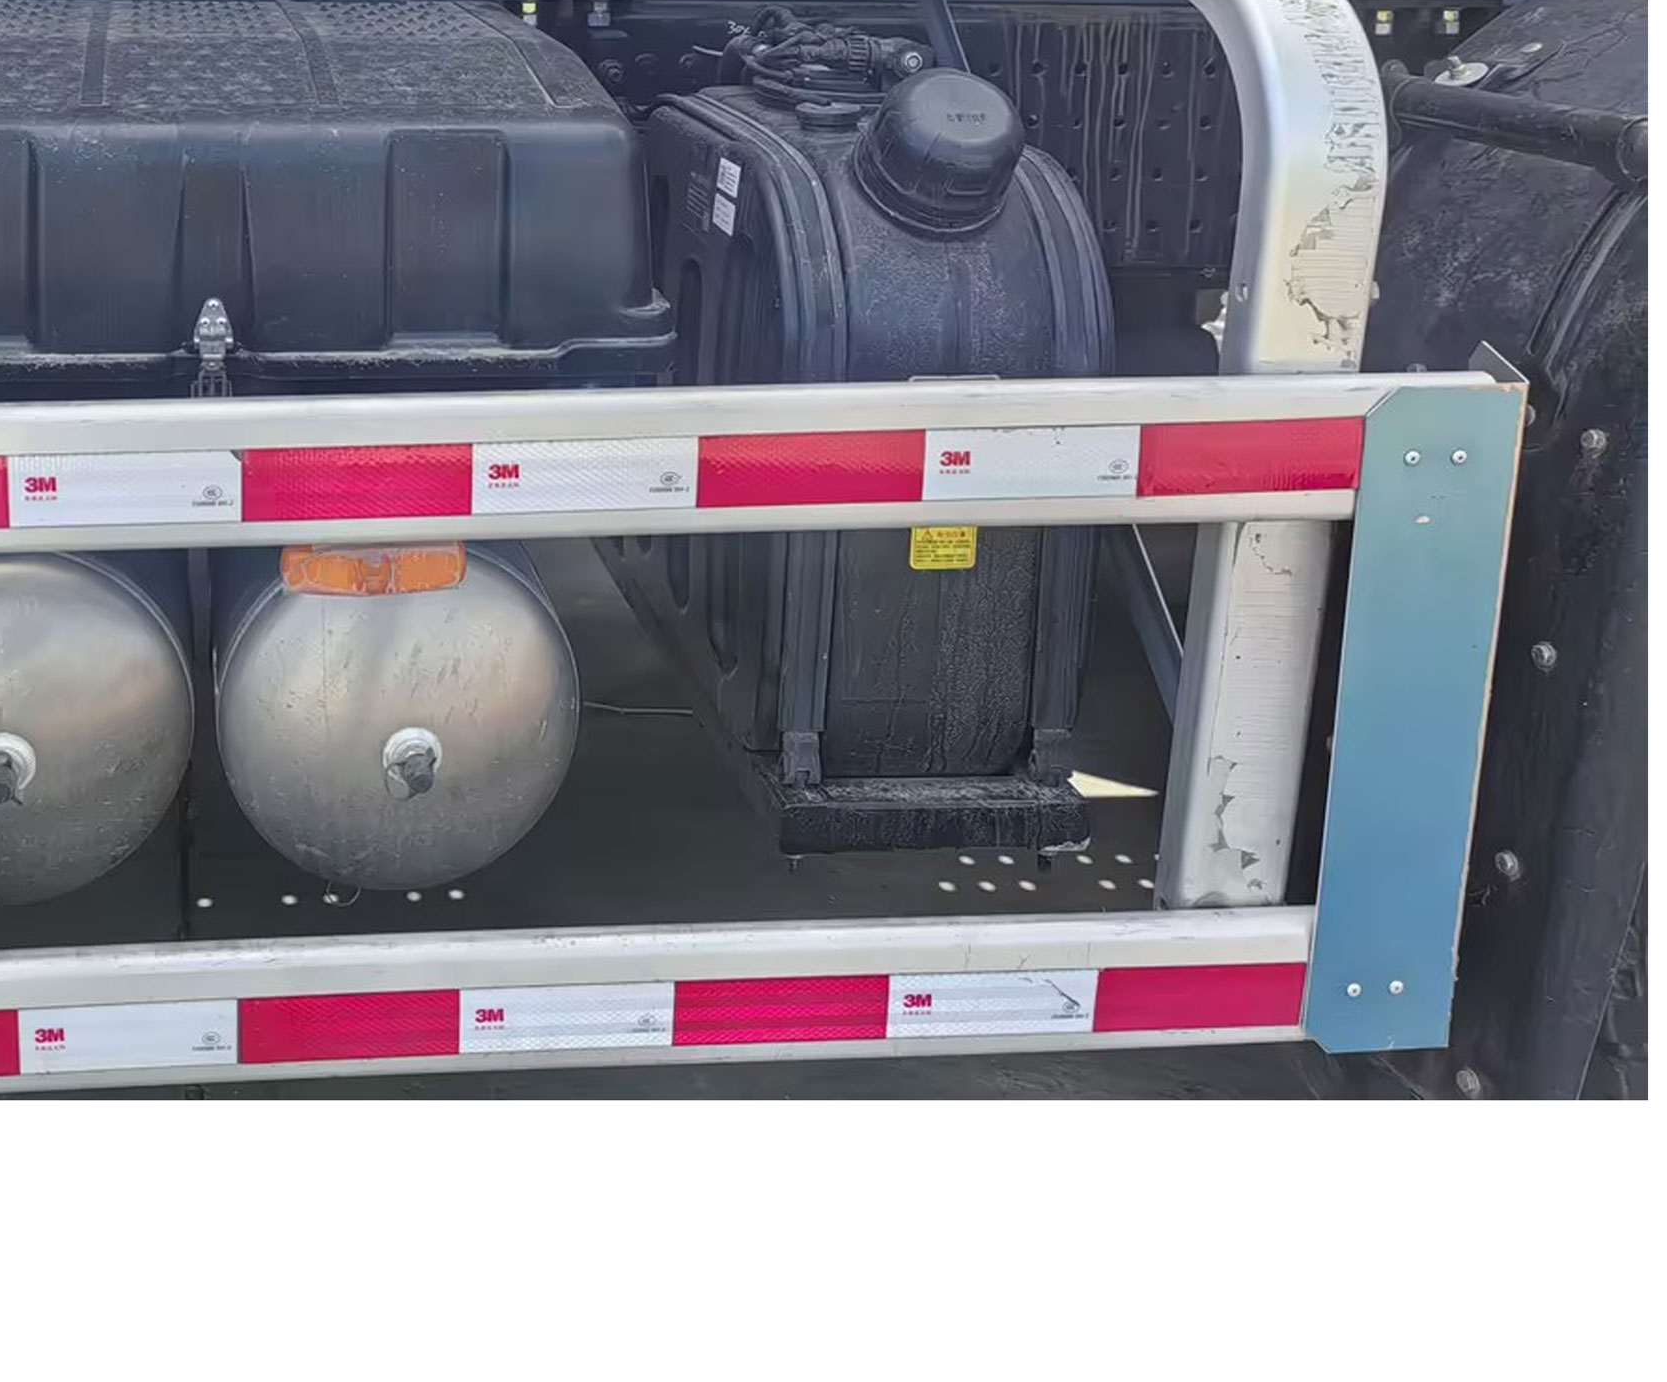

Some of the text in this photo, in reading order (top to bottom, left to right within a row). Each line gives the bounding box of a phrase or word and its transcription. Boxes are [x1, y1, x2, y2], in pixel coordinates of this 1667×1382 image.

[940, 452, 970, 465] 3M
[489, 465, 519, 478] 3M
[25, 477, 56, 492] 3M
[903, 995, 931, 1007] 3M
[476, 1009, 504, 1022] 3M
[36, 1029, 64, 1042] 3M
